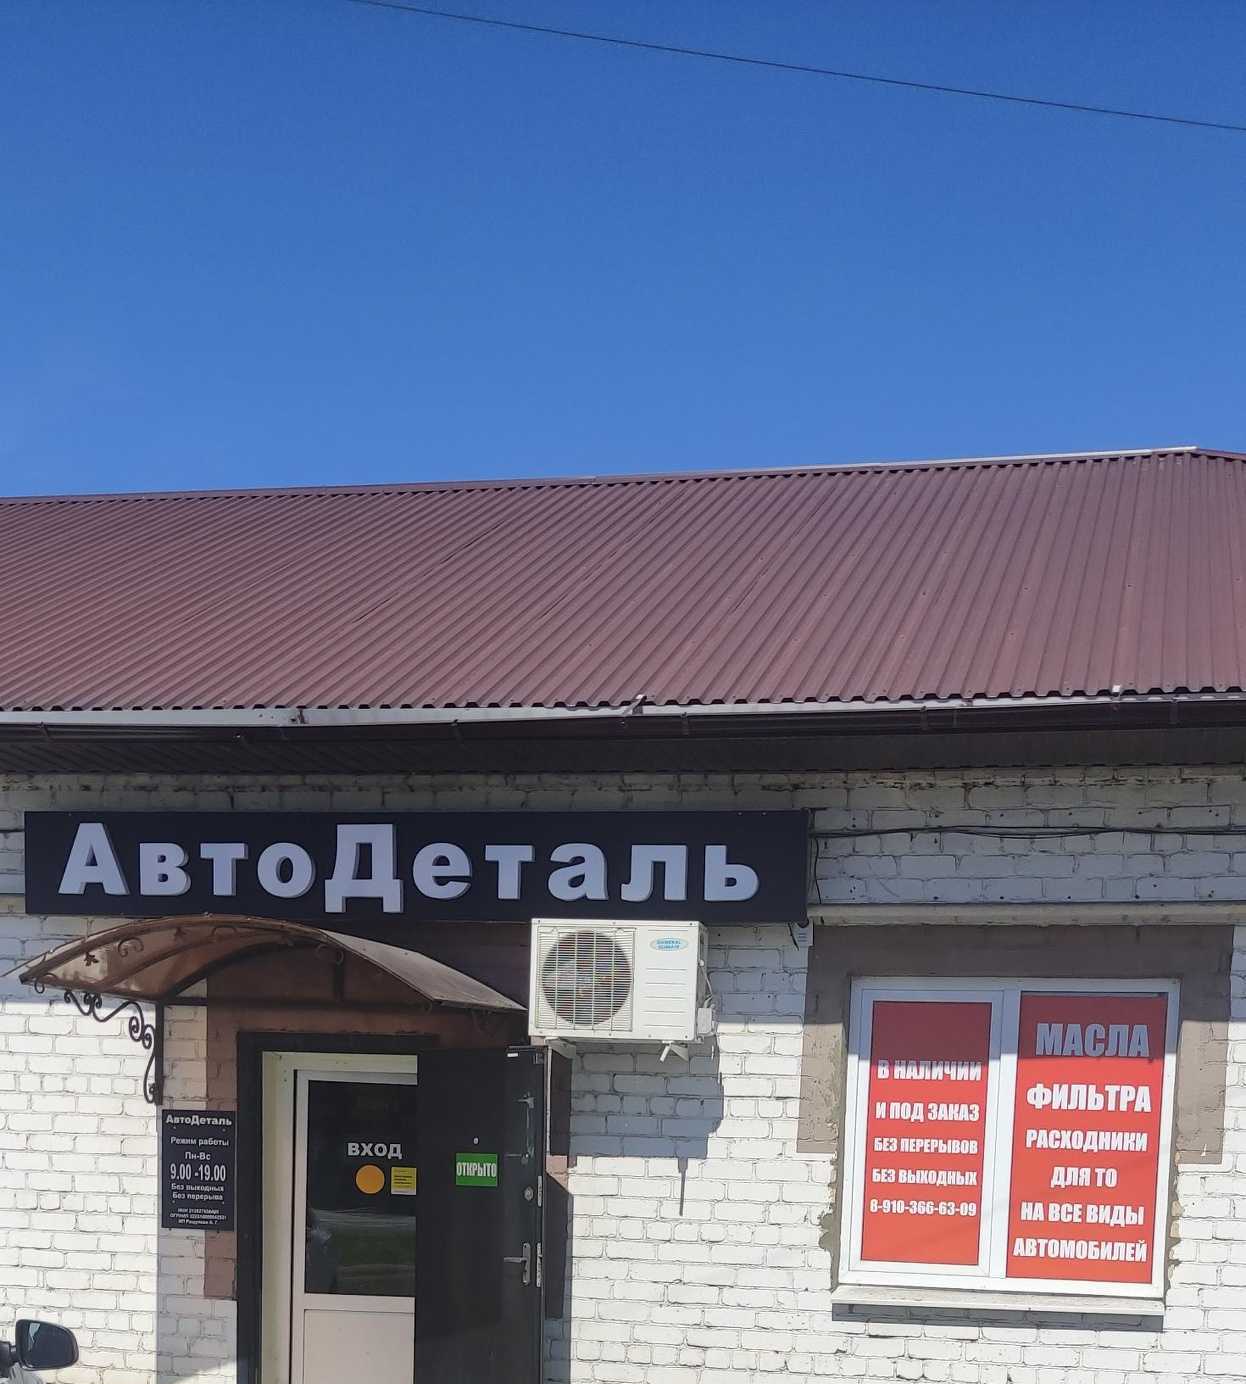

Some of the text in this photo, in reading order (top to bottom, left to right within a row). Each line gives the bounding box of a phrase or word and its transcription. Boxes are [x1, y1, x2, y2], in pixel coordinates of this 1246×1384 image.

[58, 822, 760, 913] АвтоДеталь
[1036, 1023, 1150, 1057] МАСЛА
[877, 1060, 982, 1081] В НАЛИЧИИ
[1026, 1084, 1152, 1113] ФИЛЬТРА
[166, 1114, 232, 1126] АвтоДеталь
[875, 1102, 980, 1122] И ПОД ЗАКАЗ
[170, 1136, 229, 1147] Режим работы
[874, 1137, 978, 1154] БЕЗ ПЕРЕРЫВОВ
[1025, 1129, 1148, 1152] РАСХОДНИКИ
[185, 1151, 211, 1161] Пн-Вс
[347, 1142, 403, 1160] ВХОД
[170, 1163, 192, 1180] 9.00
[456, 1161, 497, 1177] ОТКРЫТО
[872, 1168, 977, 1187] БЕЗ ВЫХОДНЫХ
[1050, 1166, 1118, 1188] ДЛЯ ТО
[869, 1198, 977, 1217] 8-910-366-63-09
[1020, 1201, 1144, 1228] НА ВСЕ ВИДЫ
[1013, 1237, 1148, 1262] АВТОМОБИЛЕЙ
